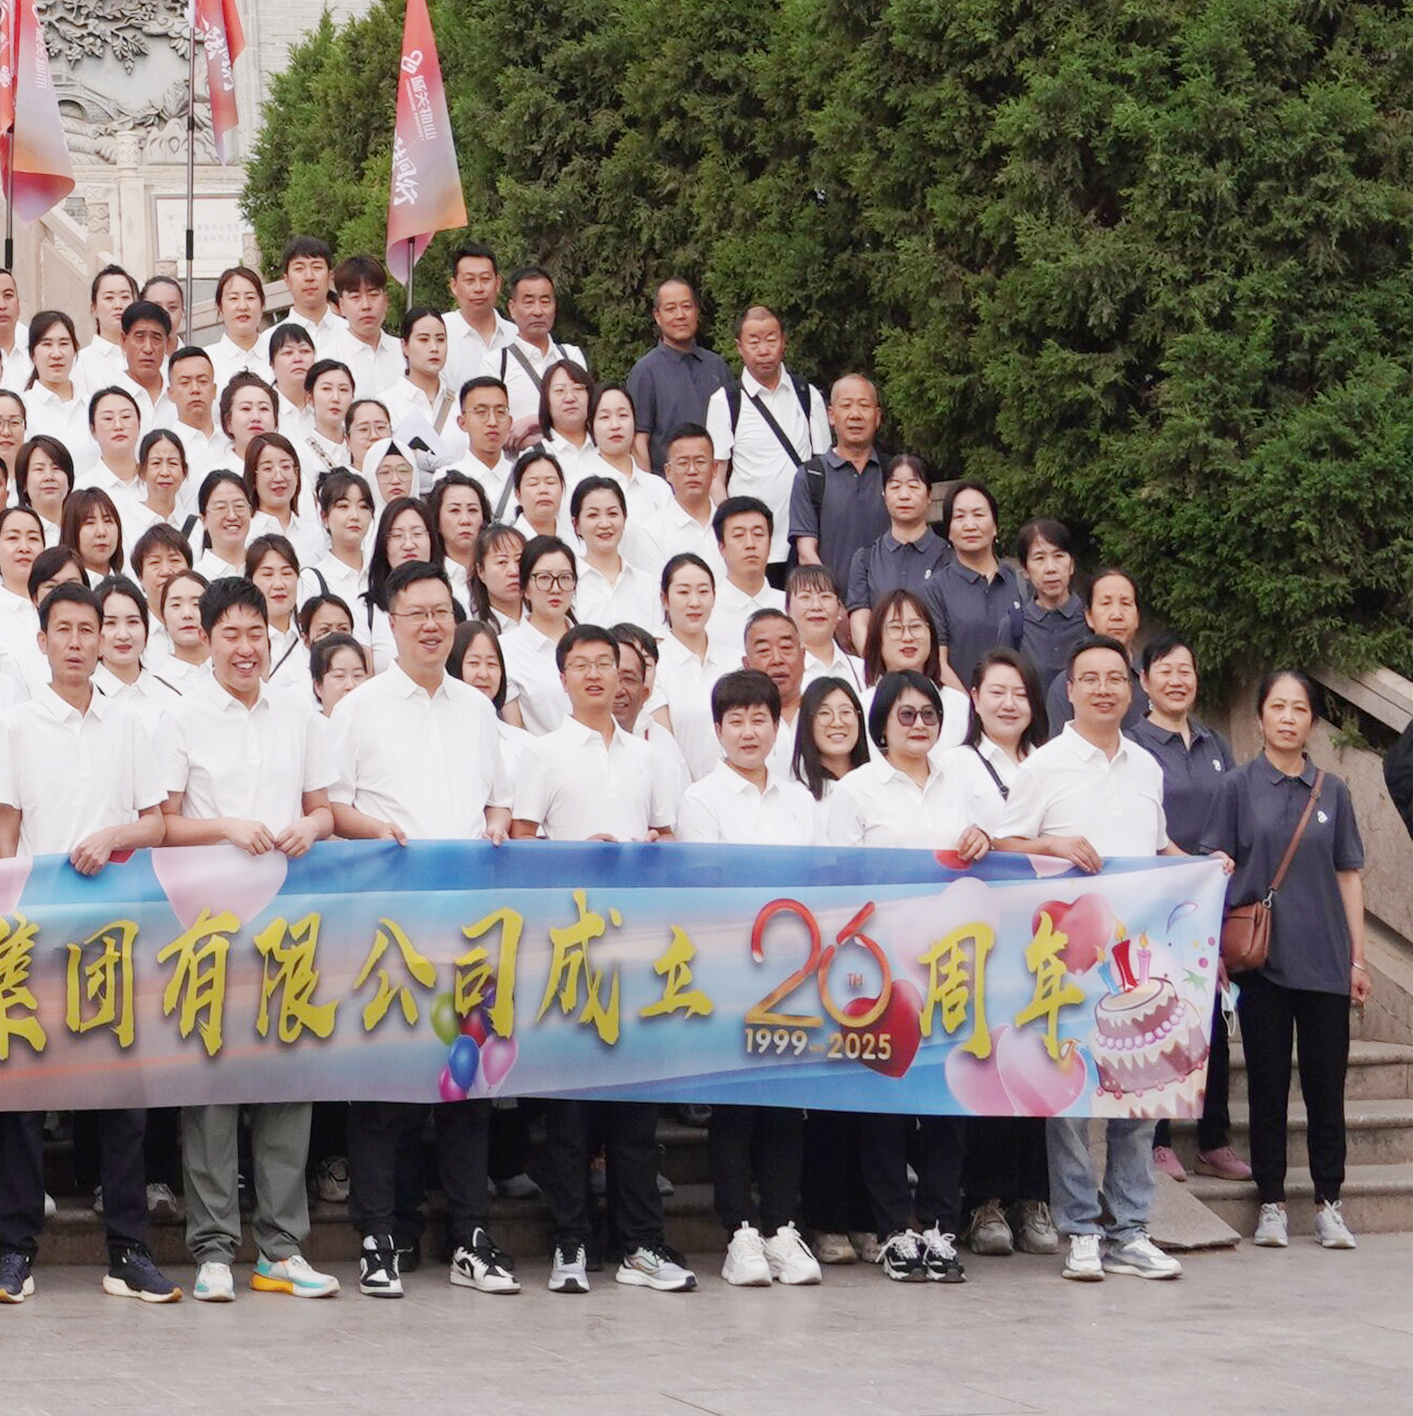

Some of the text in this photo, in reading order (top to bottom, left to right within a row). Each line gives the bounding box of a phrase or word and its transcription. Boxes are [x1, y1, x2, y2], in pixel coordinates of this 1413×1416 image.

[410, 74, 438, 140] 城关物业
[744, 1027, 892, 1061] 1999-2025
